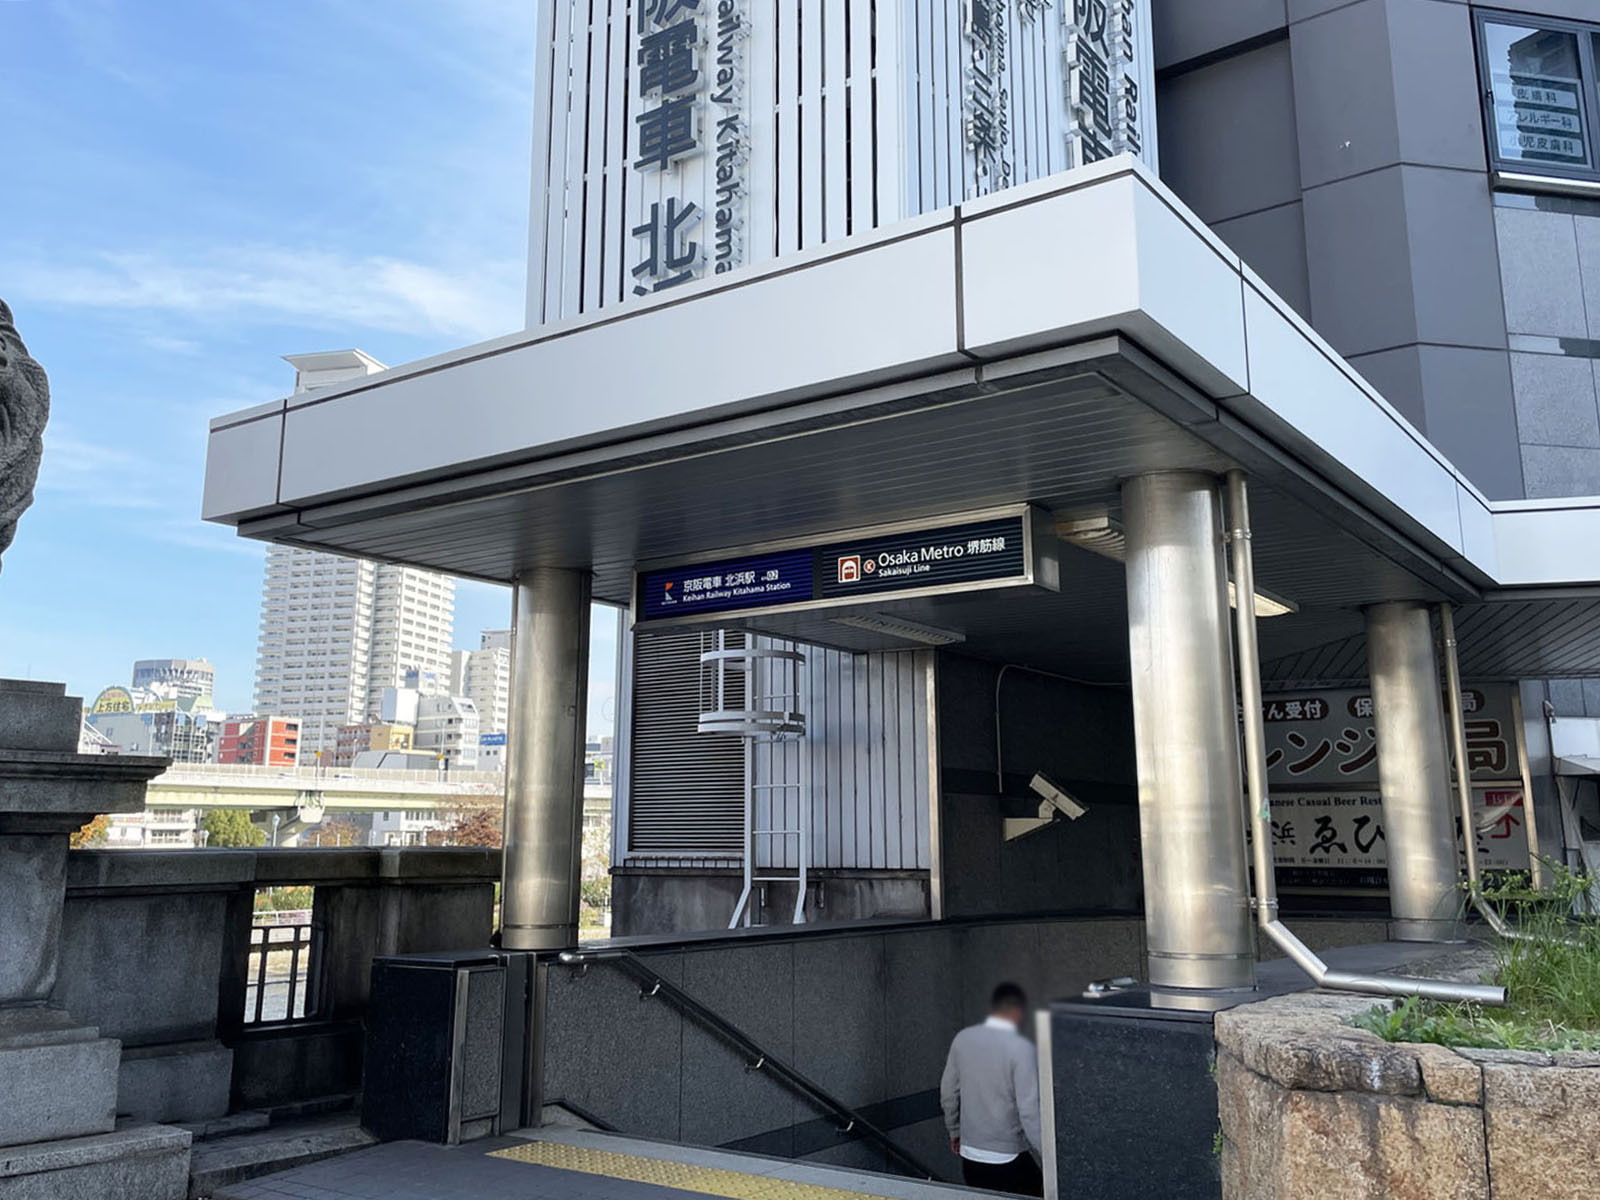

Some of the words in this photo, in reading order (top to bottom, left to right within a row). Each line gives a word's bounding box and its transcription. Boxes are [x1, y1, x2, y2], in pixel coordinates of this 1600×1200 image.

[966, 537, 1005, 554] 堺筋線
[878, 550, 919, 567] Osaka
[920, 545, 964, 562] Metro
[878, 566, 912, 578] Sakaisuji
[913, 563, 931, 574] Line
[683, 576, 722, 592] 京阪電車
[724, 571, 756, 588] 北浜駅
[683, 592, 705, 602] Keihan
[706, 587, 731, 600] Railway
[733, 583, 765, 596] Kitahama
[766, 582, 791, 592] Station
[1262, 700, 1321, 720] ん受付
[1298, 796, 1331, 807] Casual
[1334, 796, 1357, 806] Beer
